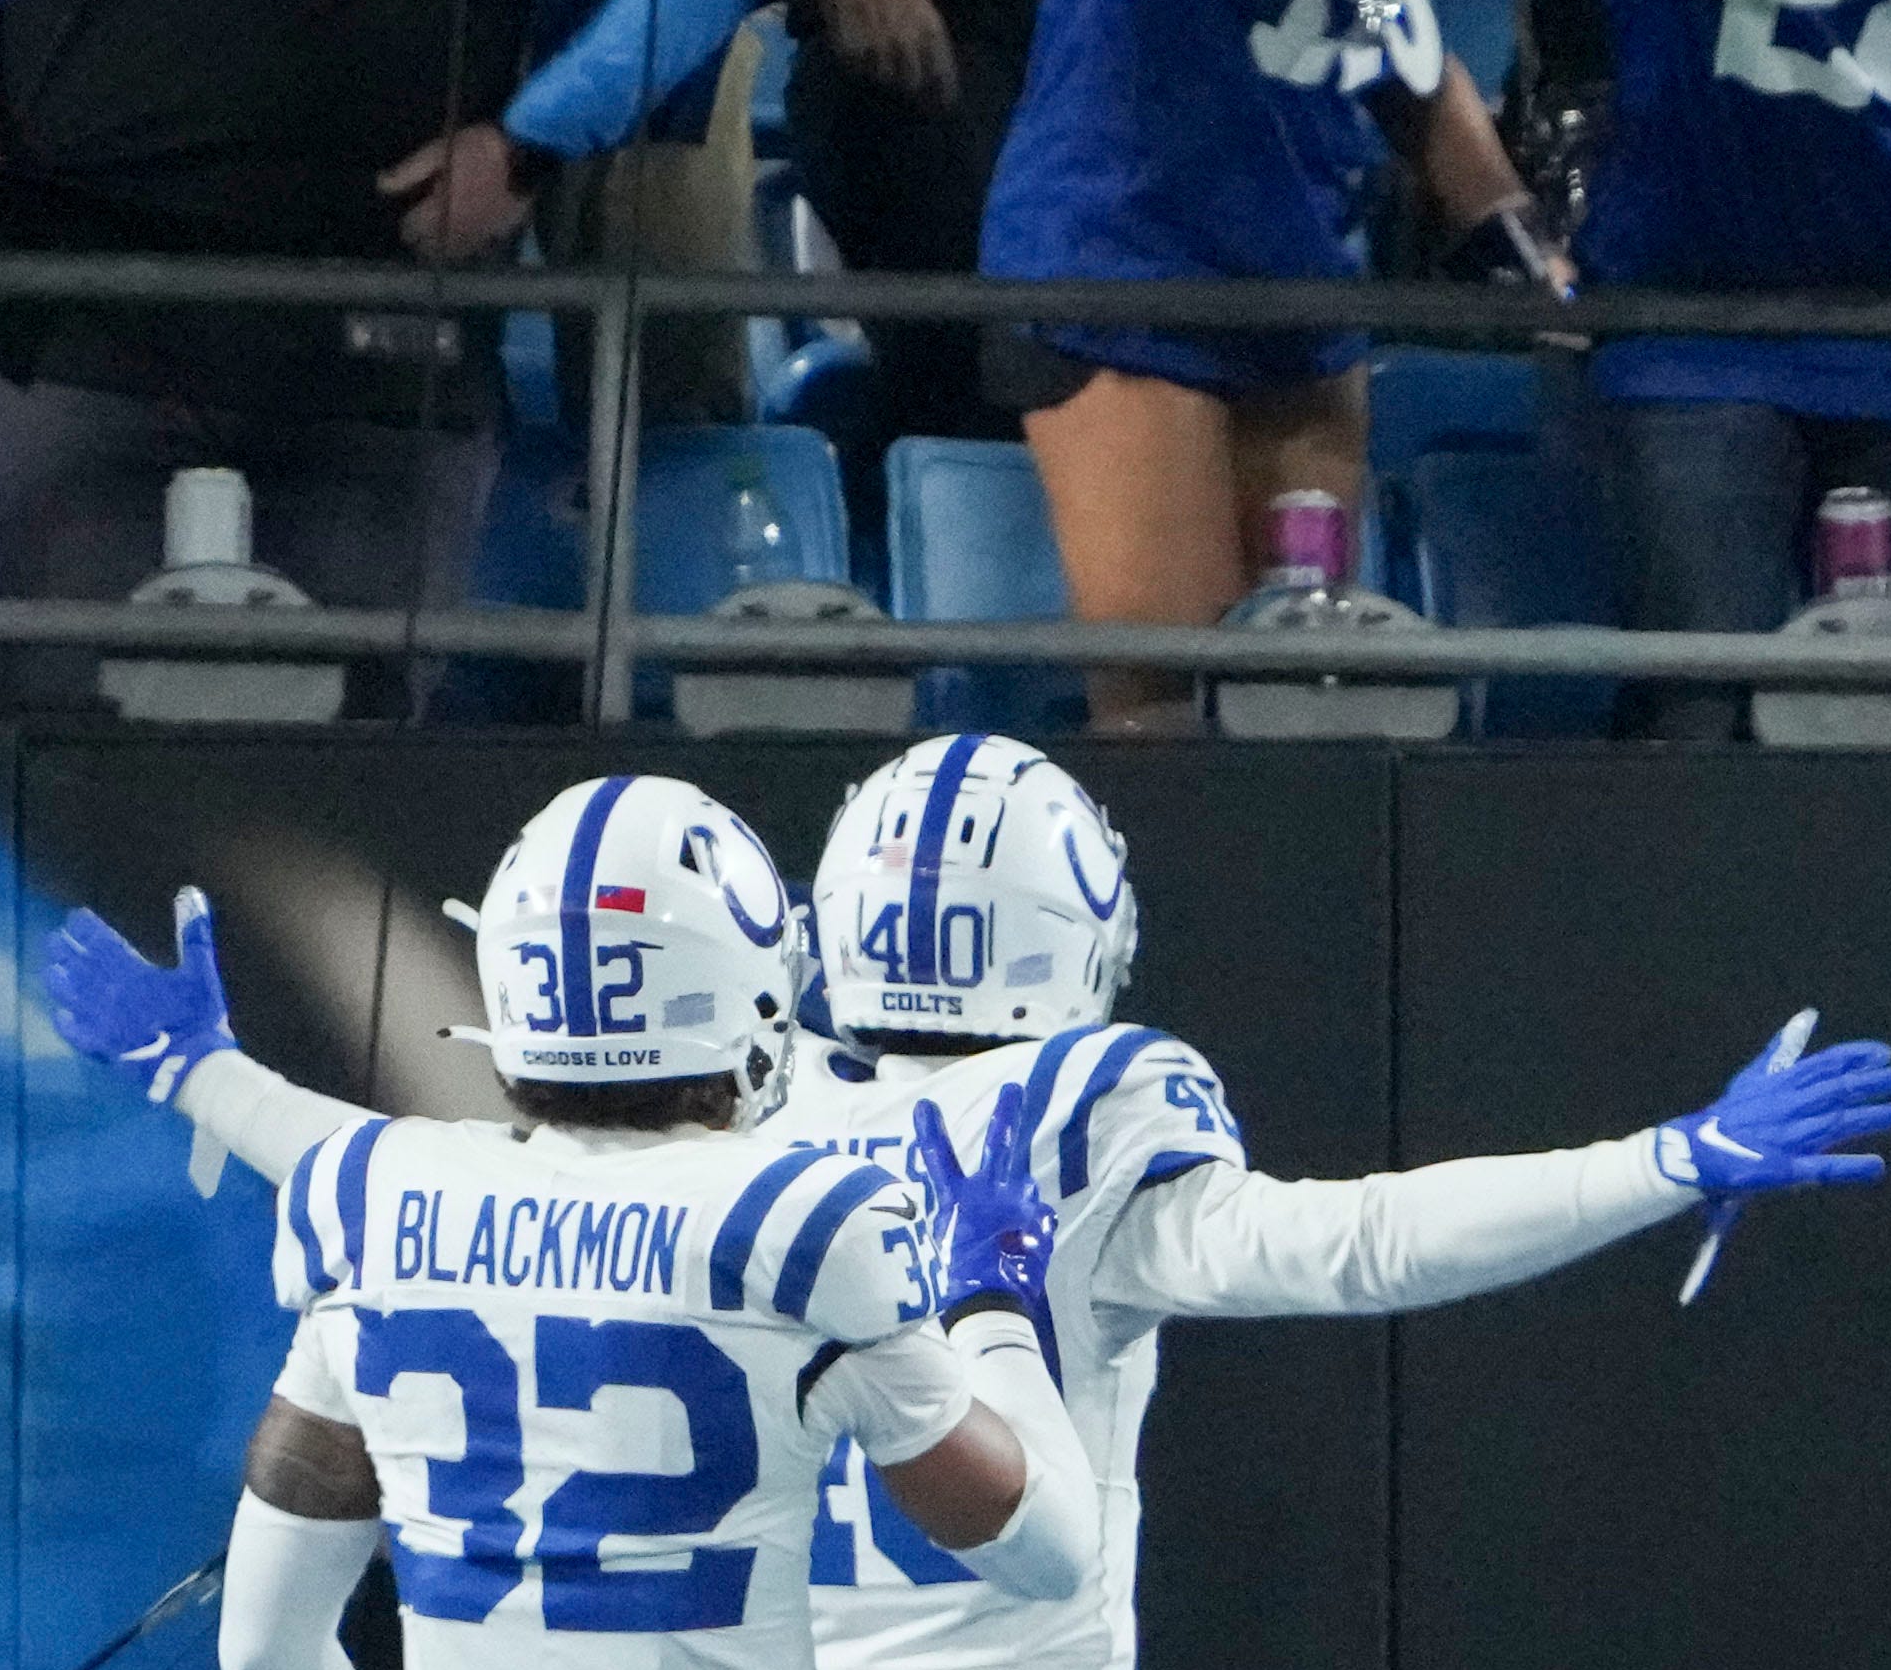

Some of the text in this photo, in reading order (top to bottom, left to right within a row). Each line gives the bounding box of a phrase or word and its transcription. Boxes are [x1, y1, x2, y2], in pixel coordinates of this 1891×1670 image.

[516, 942, 648, 1035] 32
[862, 903, 985, 989] 40
[881, 991, 964, 1017] COLTS
[522, 1048, 662, 1068] CHOOSE LOVE
[395, 1189, 688, 1296] BLACKMON
[353, 1305, 759, 1632] 32
